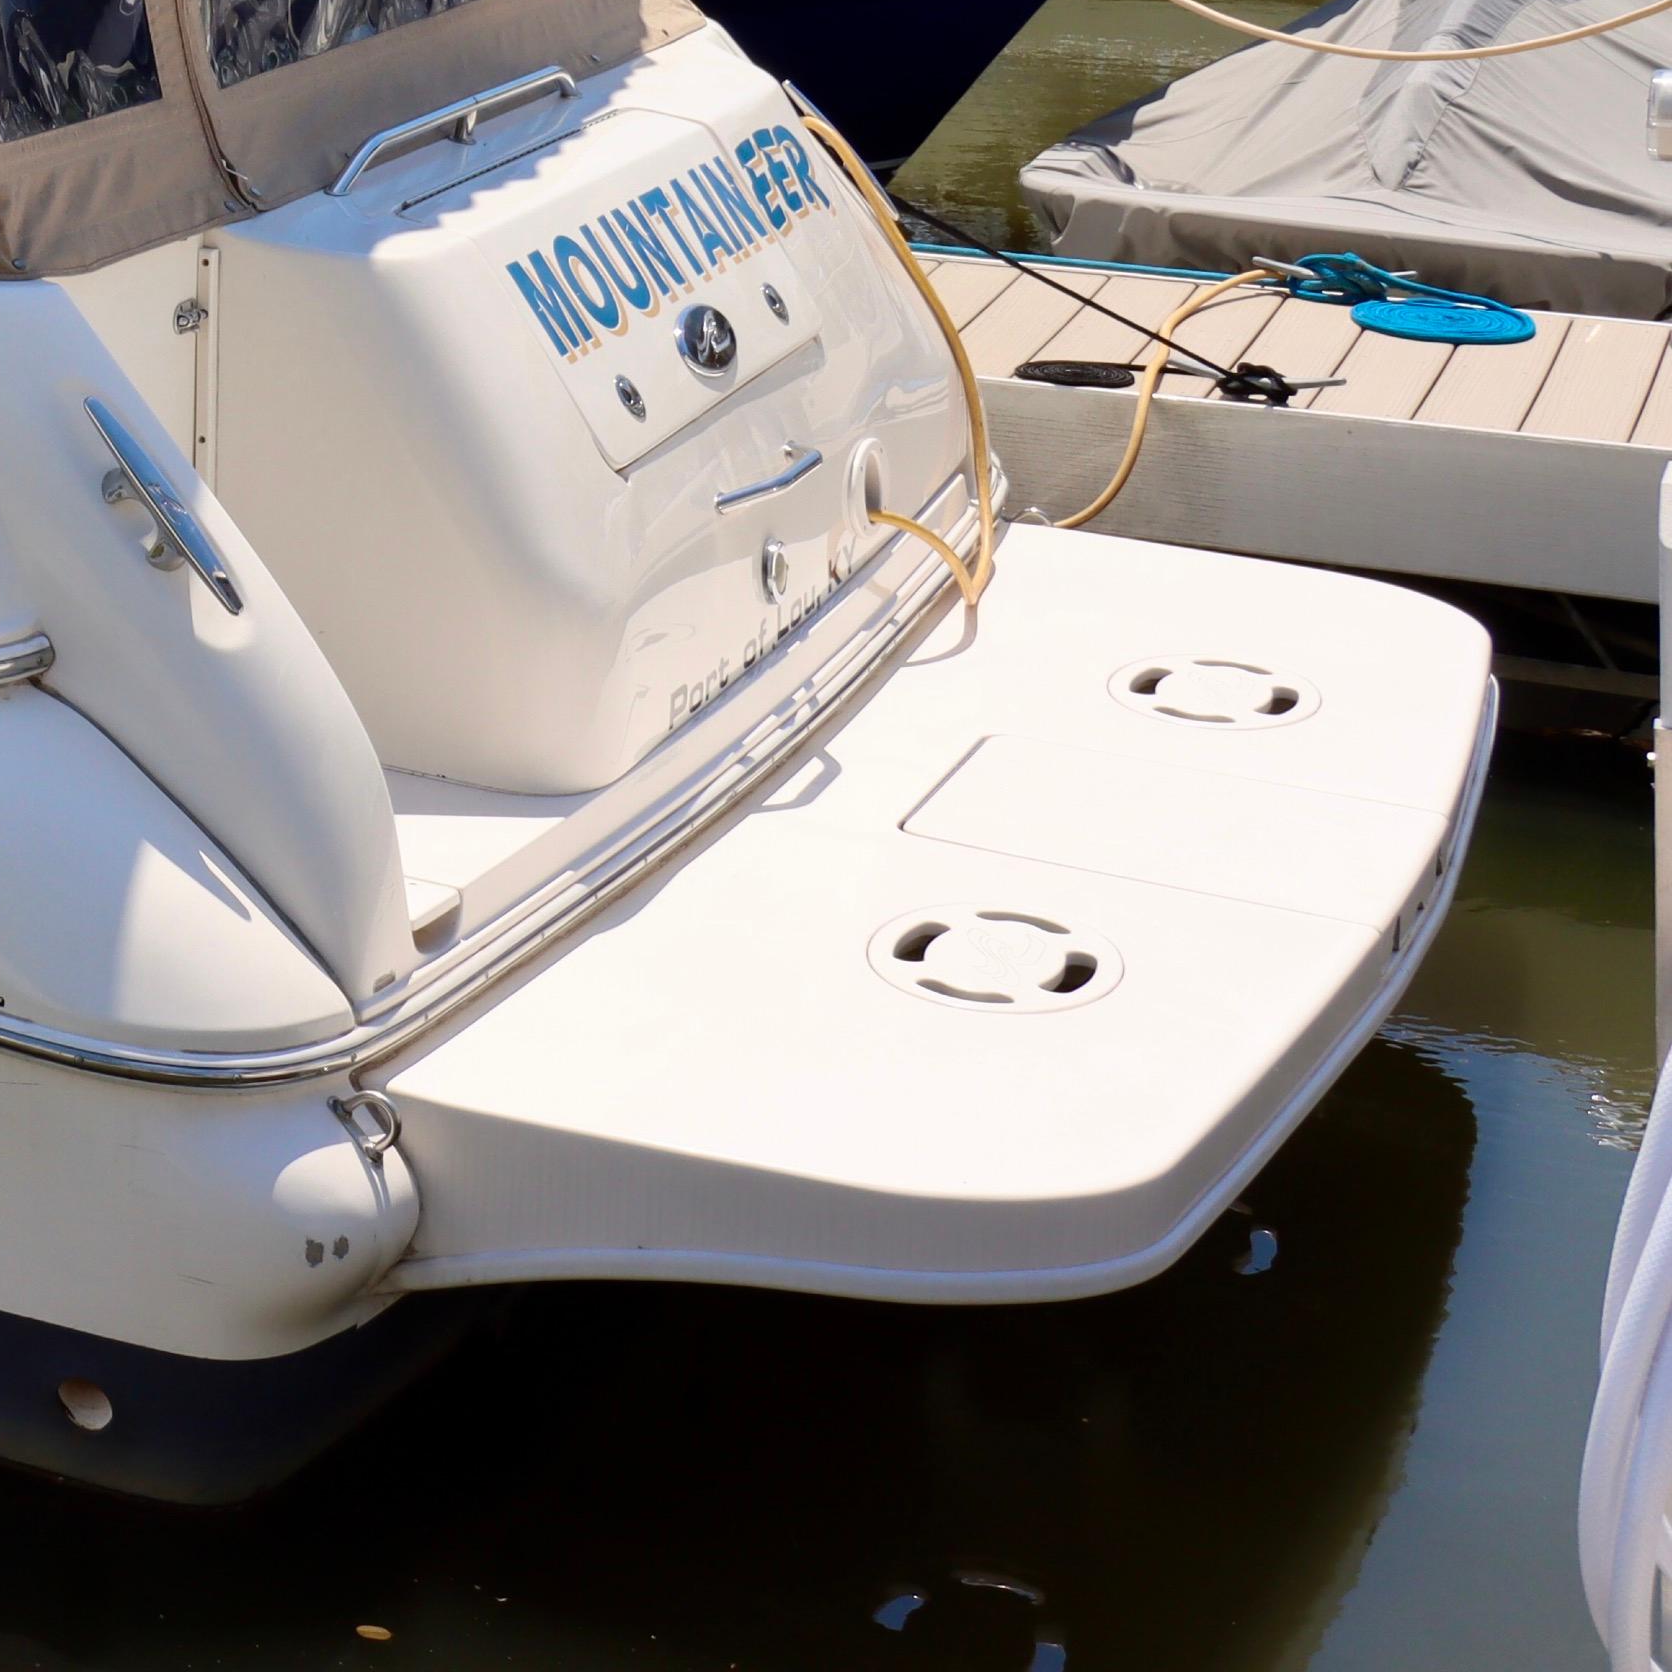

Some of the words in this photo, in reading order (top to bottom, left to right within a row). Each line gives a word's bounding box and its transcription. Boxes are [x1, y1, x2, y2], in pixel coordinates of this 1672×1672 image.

[504, 124, 836, 364] MOUNTAINEER
[669, 657, 730, 731] Port
[743, 617, 767, 669] of
